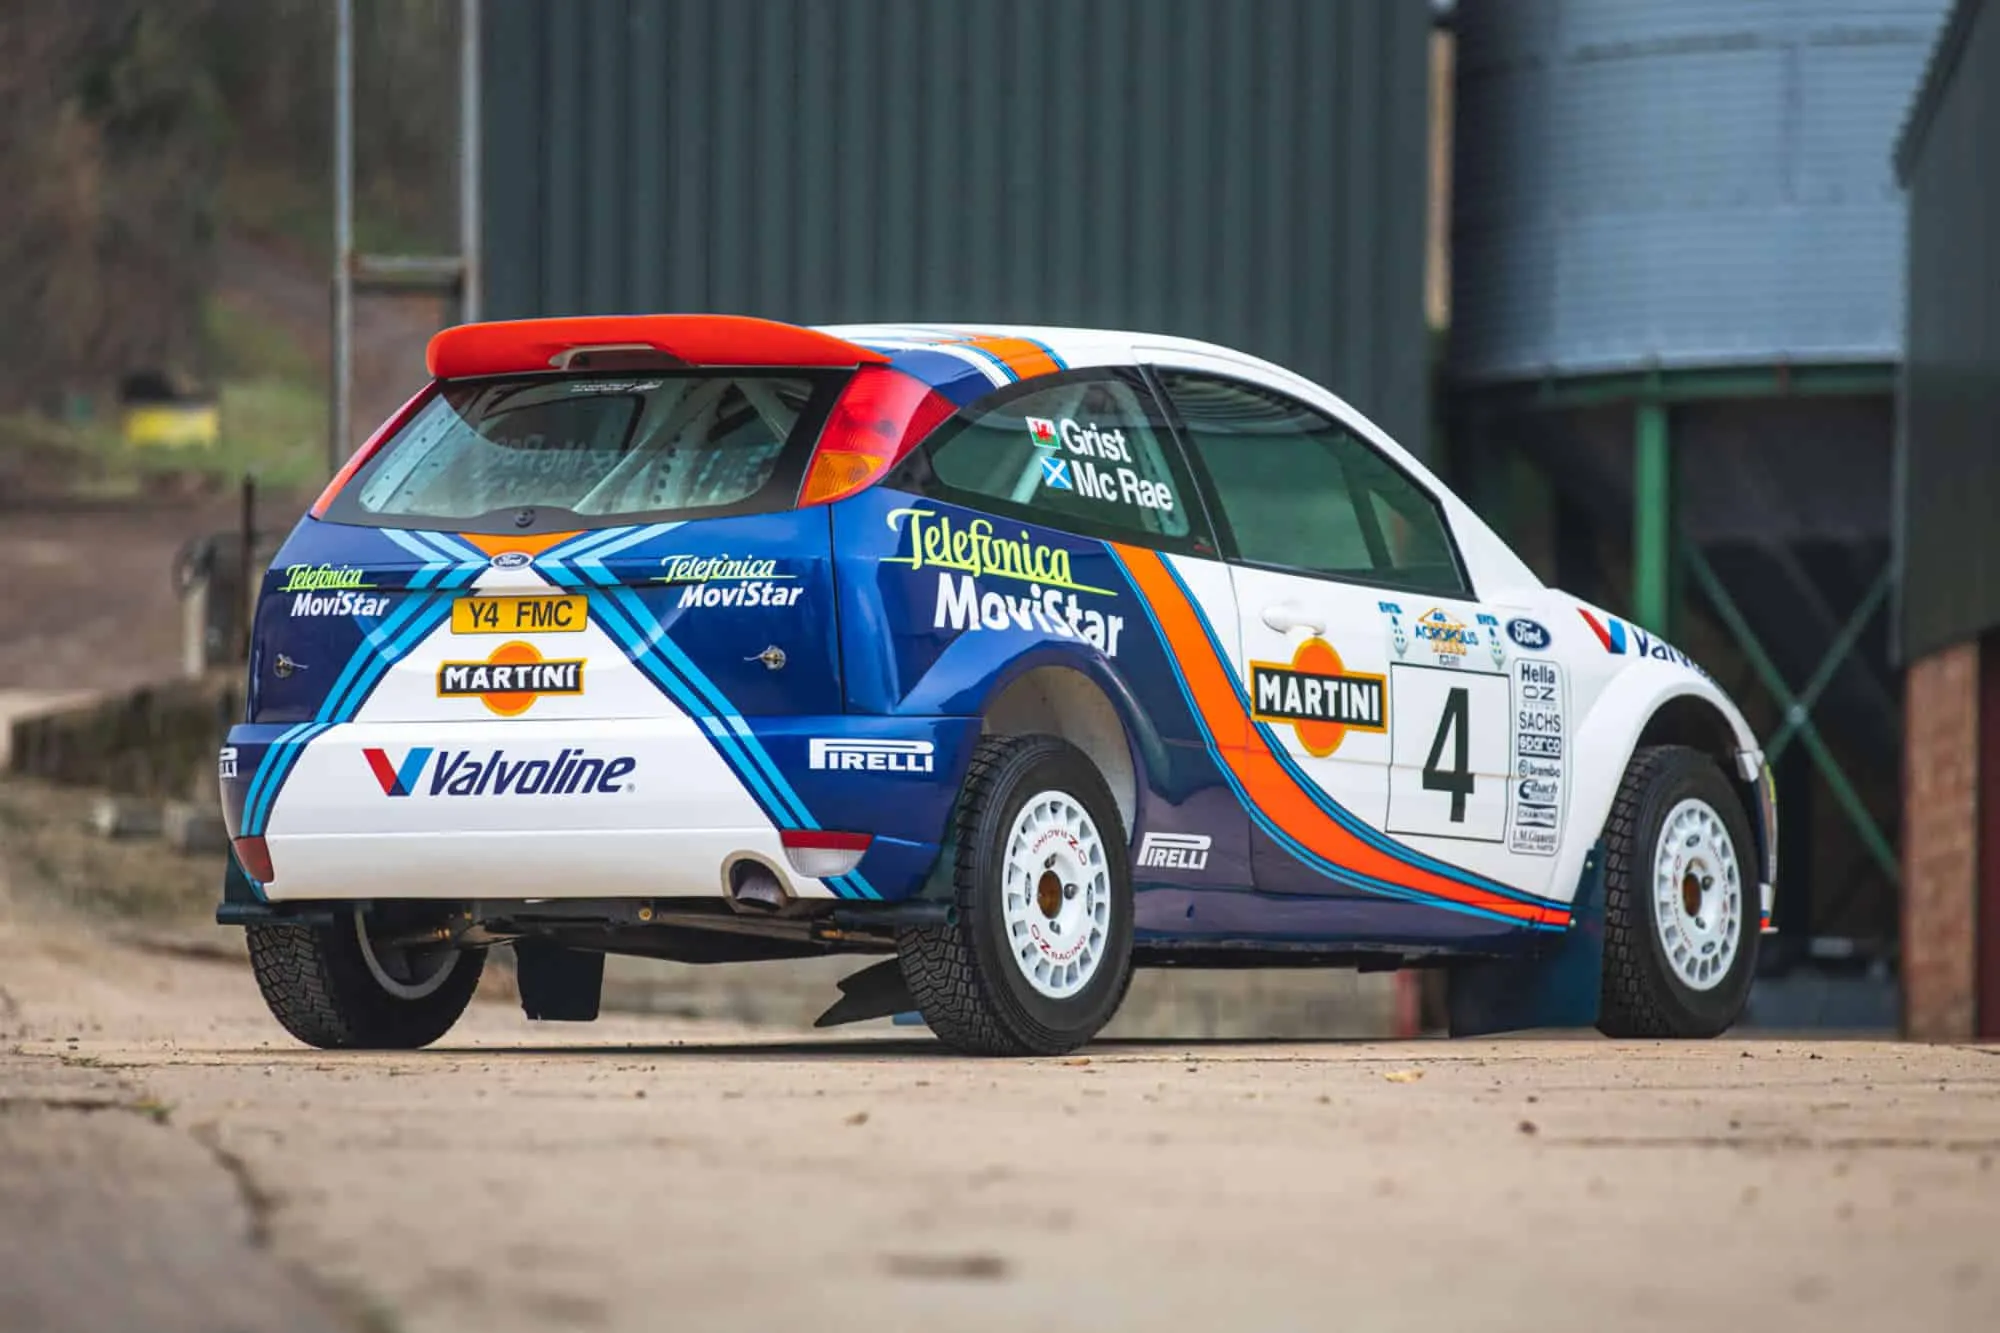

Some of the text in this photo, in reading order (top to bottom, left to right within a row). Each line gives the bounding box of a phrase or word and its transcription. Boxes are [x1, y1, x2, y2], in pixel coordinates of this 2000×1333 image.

[1060, 418, 1132, 463] Grist
[1071, 460, 1174, 512] Mc Rae
[290, 590, 390, 617] MoviStar
[677, 581, 803, 609] MoviStar
[469, 600, 573, 628] Y4 FMC
[933, 572, 1124, 658] MoviStar
[1513, 619, 1545, 646] Ford
[444, 664, 577, 690] MARTINI
[1521, 663, 1556, 684] Hella
[1258, 674, 1380, 722] MARTINI
[1519, 711, 1561, 733] SACHS
[809, 738, 934, 772] PIRELLI
[1422, 687, 1475, 823] 4
[1529, 762, 1561, 778] brembo
[430, 749, 635, 796] Valvoline
[1136, 832, 1212, 871] PIRELLI
